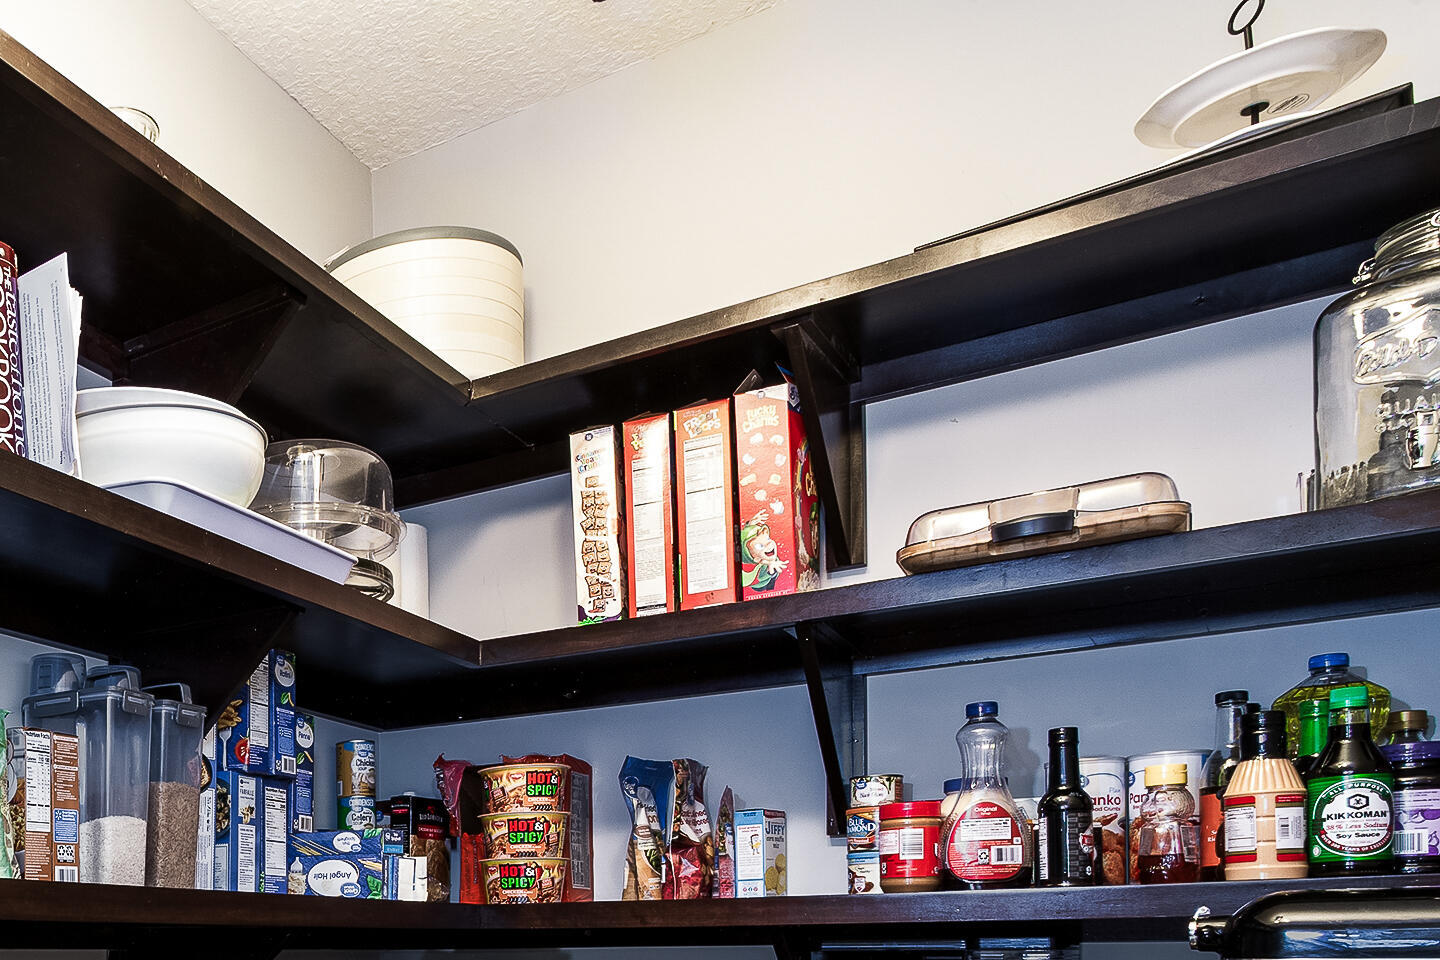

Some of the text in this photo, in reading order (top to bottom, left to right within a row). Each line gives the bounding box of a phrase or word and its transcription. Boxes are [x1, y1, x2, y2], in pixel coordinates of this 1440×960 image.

[527, 772, 557, 784] HOT &
[527, 785, 557, 796] SPICY
[1092, 794, 1121, 806] anko
[1326, 810, 1388, 821] KIKKOMAN
[509, 820, 543, 831] HOT &
[766, 824, 785, 836] JIFFY
[509, 831, 544, 843] SPICY
[501, 865, 535, 877] HOT &
[501, 877, 535, 888] SPICY
